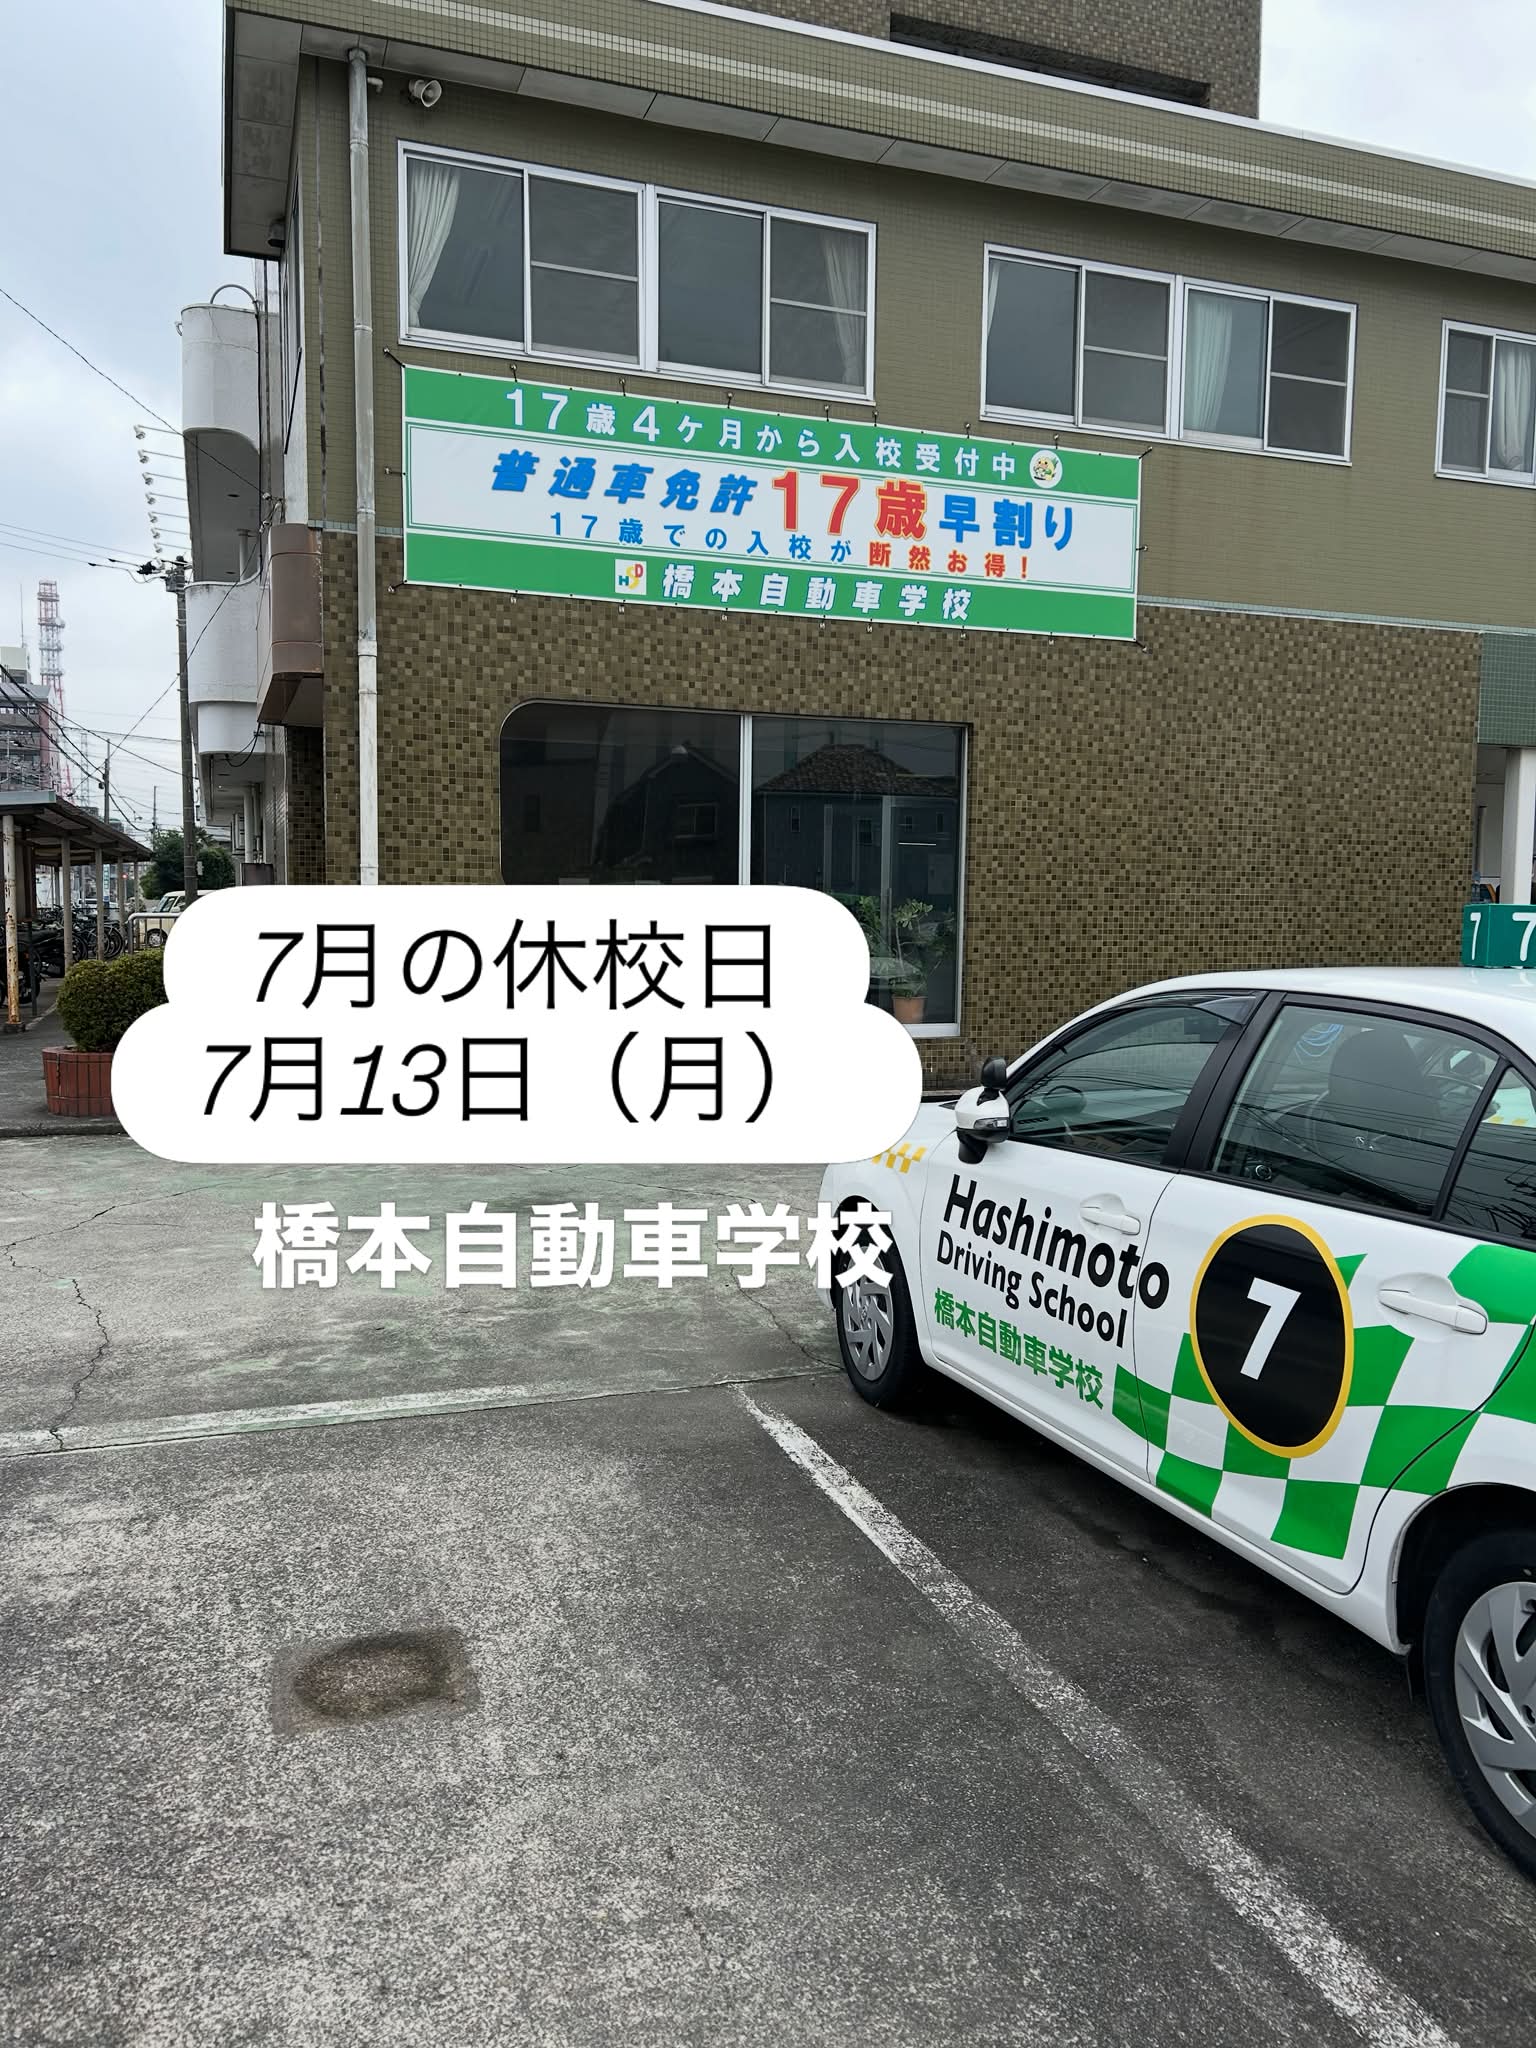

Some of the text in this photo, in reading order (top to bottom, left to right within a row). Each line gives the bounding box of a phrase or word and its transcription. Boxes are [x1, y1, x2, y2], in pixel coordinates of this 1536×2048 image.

[662, 563, 973, 621] 橋本自動車学校
[936, 1229, 1128, 1348] Driving School
[943, 1174, 1170, 1310] Hashimoto
[934, 1286, 1104, 1410] 橋本自動車学校
[1246, 1277, 1302, 1381] 7
